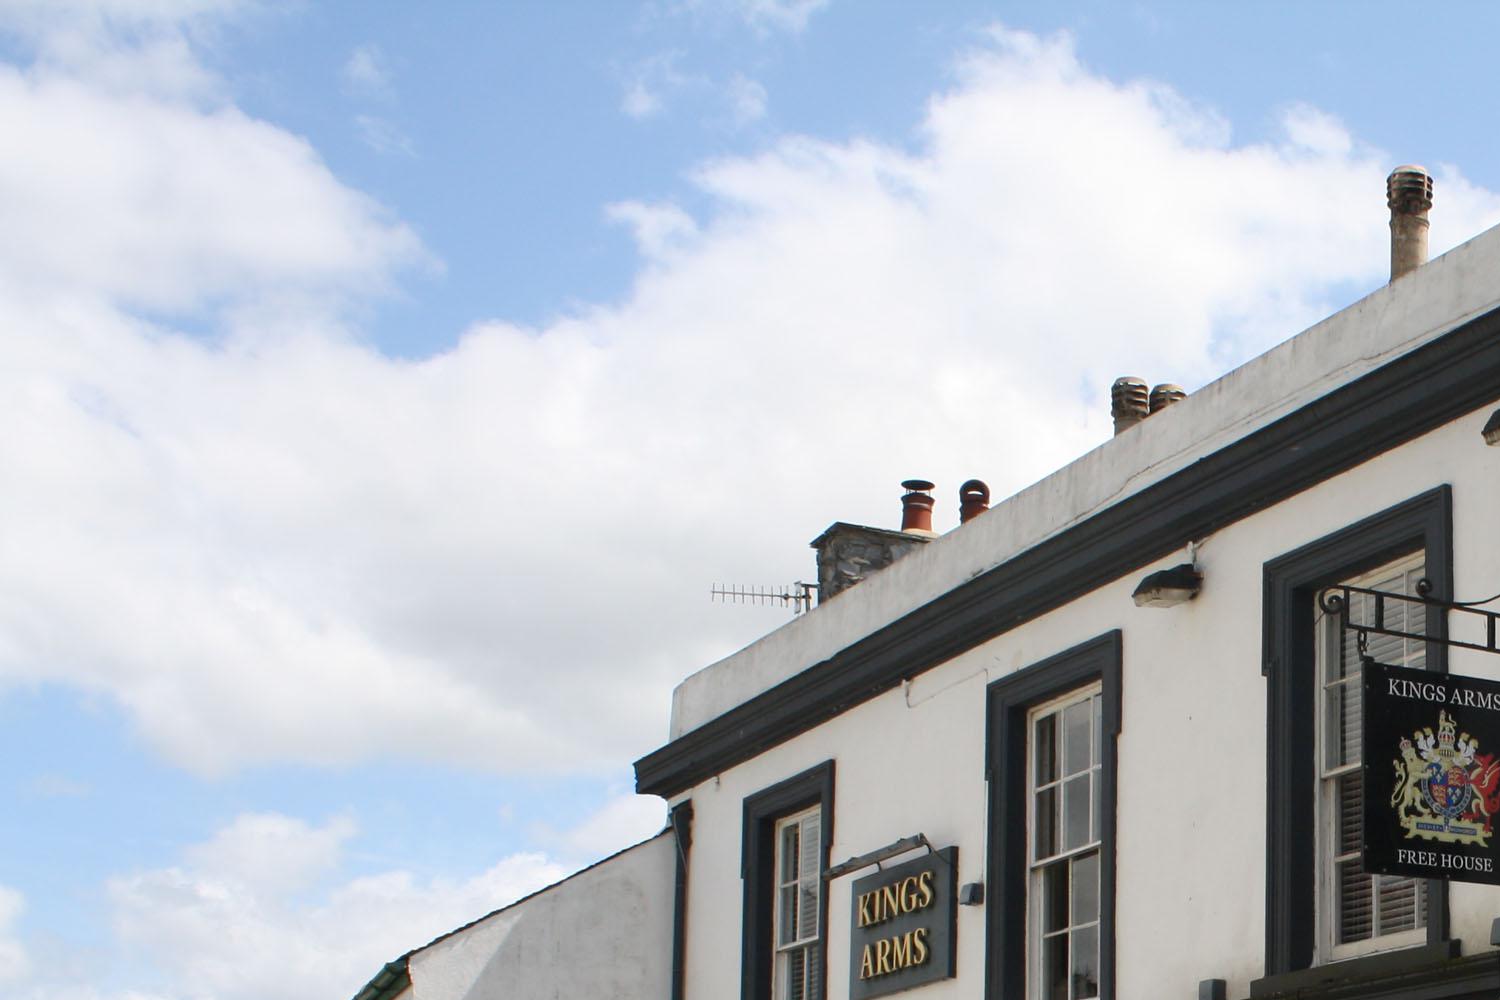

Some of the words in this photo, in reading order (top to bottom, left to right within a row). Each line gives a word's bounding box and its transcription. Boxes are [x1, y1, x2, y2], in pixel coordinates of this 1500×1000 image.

[1388, 678, 1447, 703] KINGS
[1398, 849, 1438, 868] FREE
[1441, 854, 1493, 873] HOUSE
[857, 871, 934, 928] KINGS
[859, 927, 928, 980] ARMS
